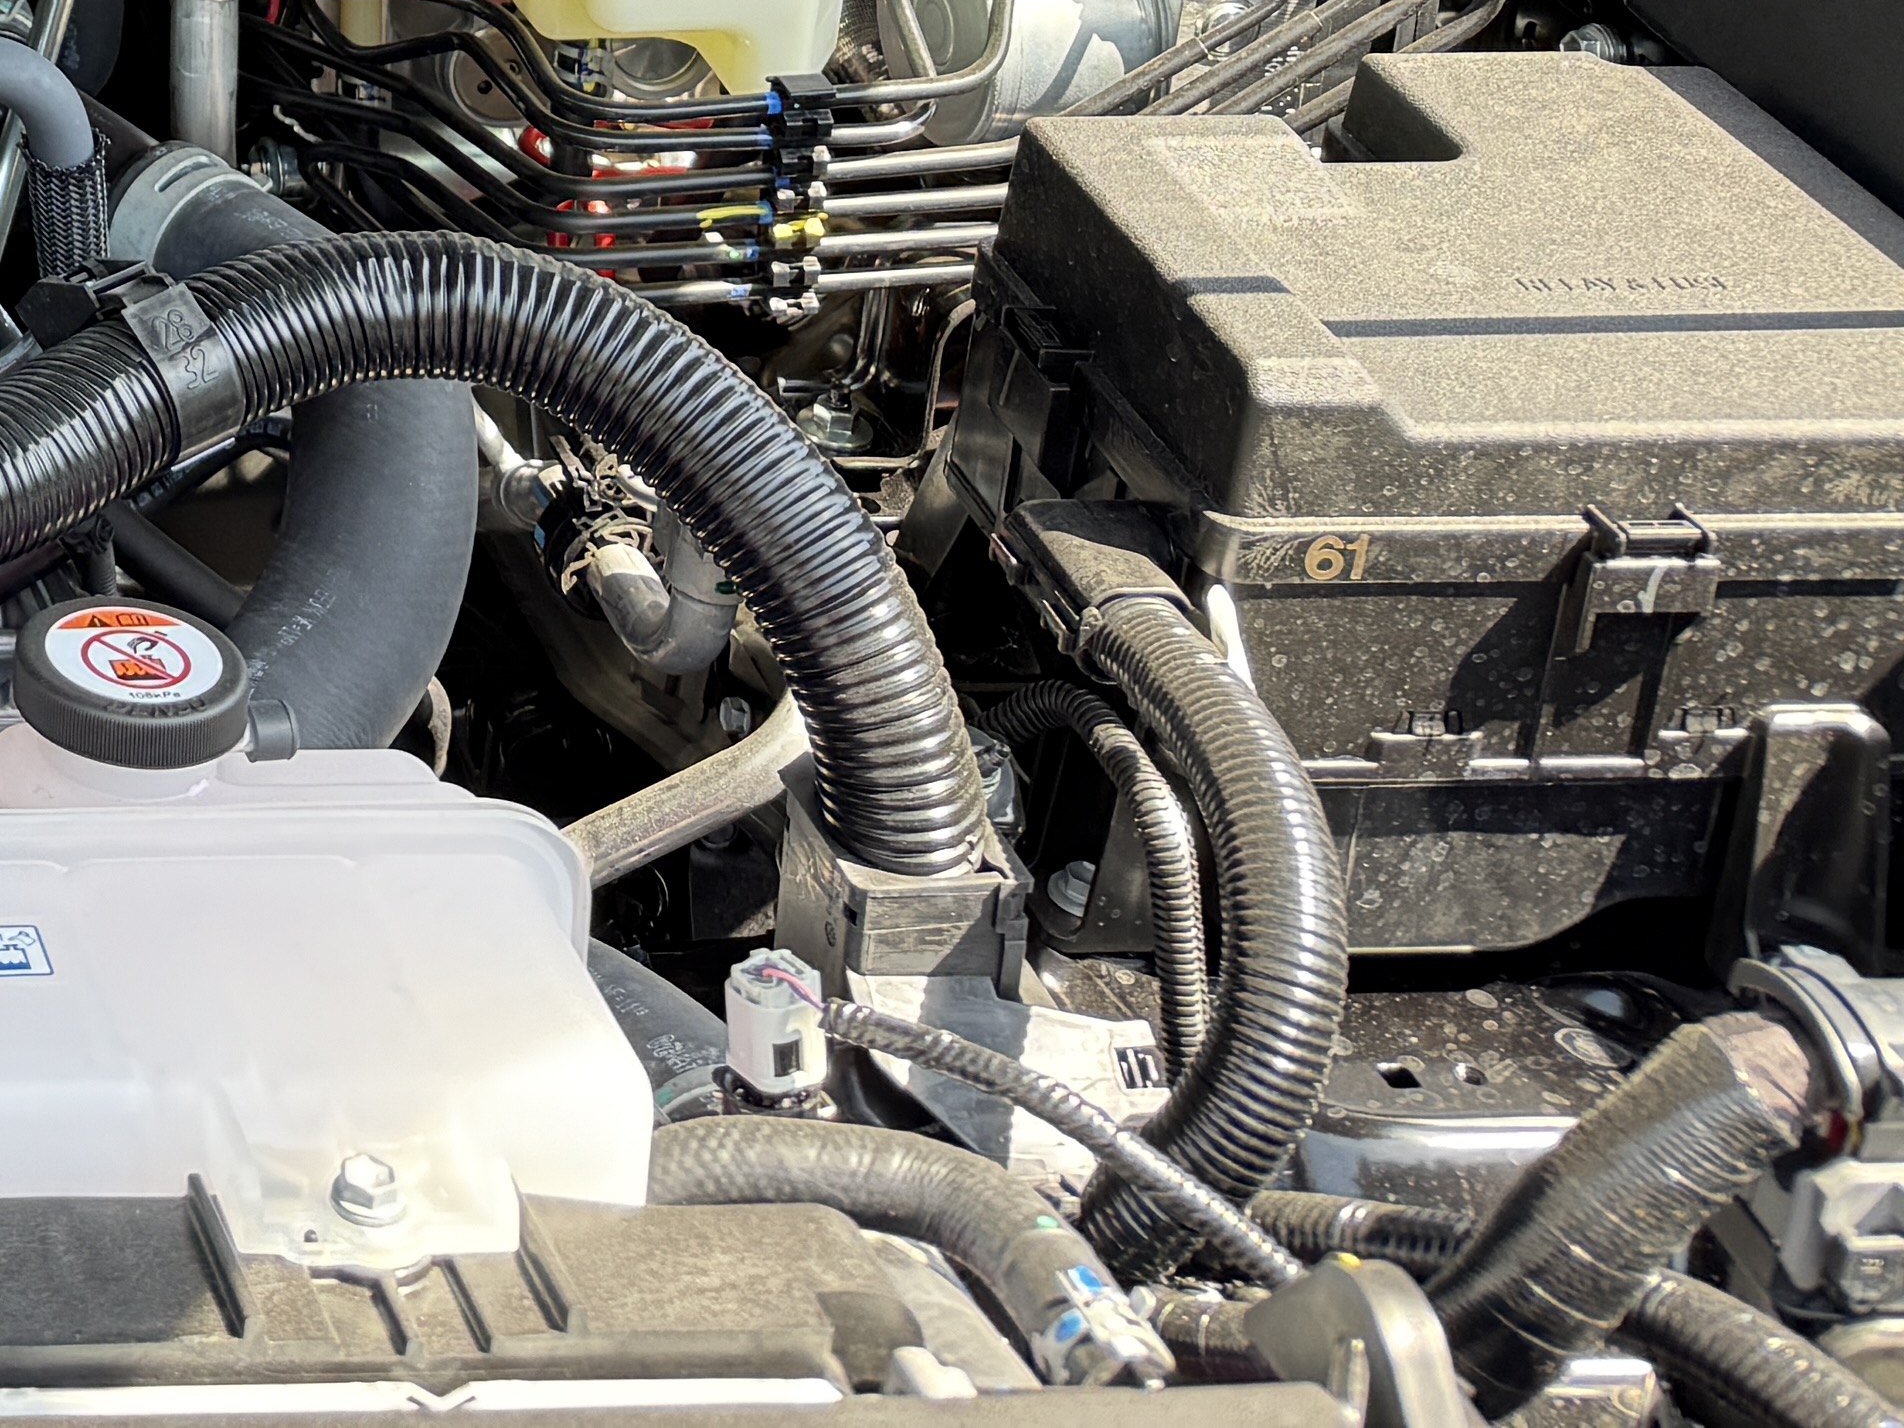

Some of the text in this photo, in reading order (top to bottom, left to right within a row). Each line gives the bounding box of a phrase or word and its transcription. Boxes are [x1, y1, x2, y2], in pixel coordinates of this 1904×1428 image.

[152, 308, 194, 351] 28
[177, 344, 218, 389] 32
[1304, 533, 1371, 581] 61
[127, 690, 182, 700] 108kPa
